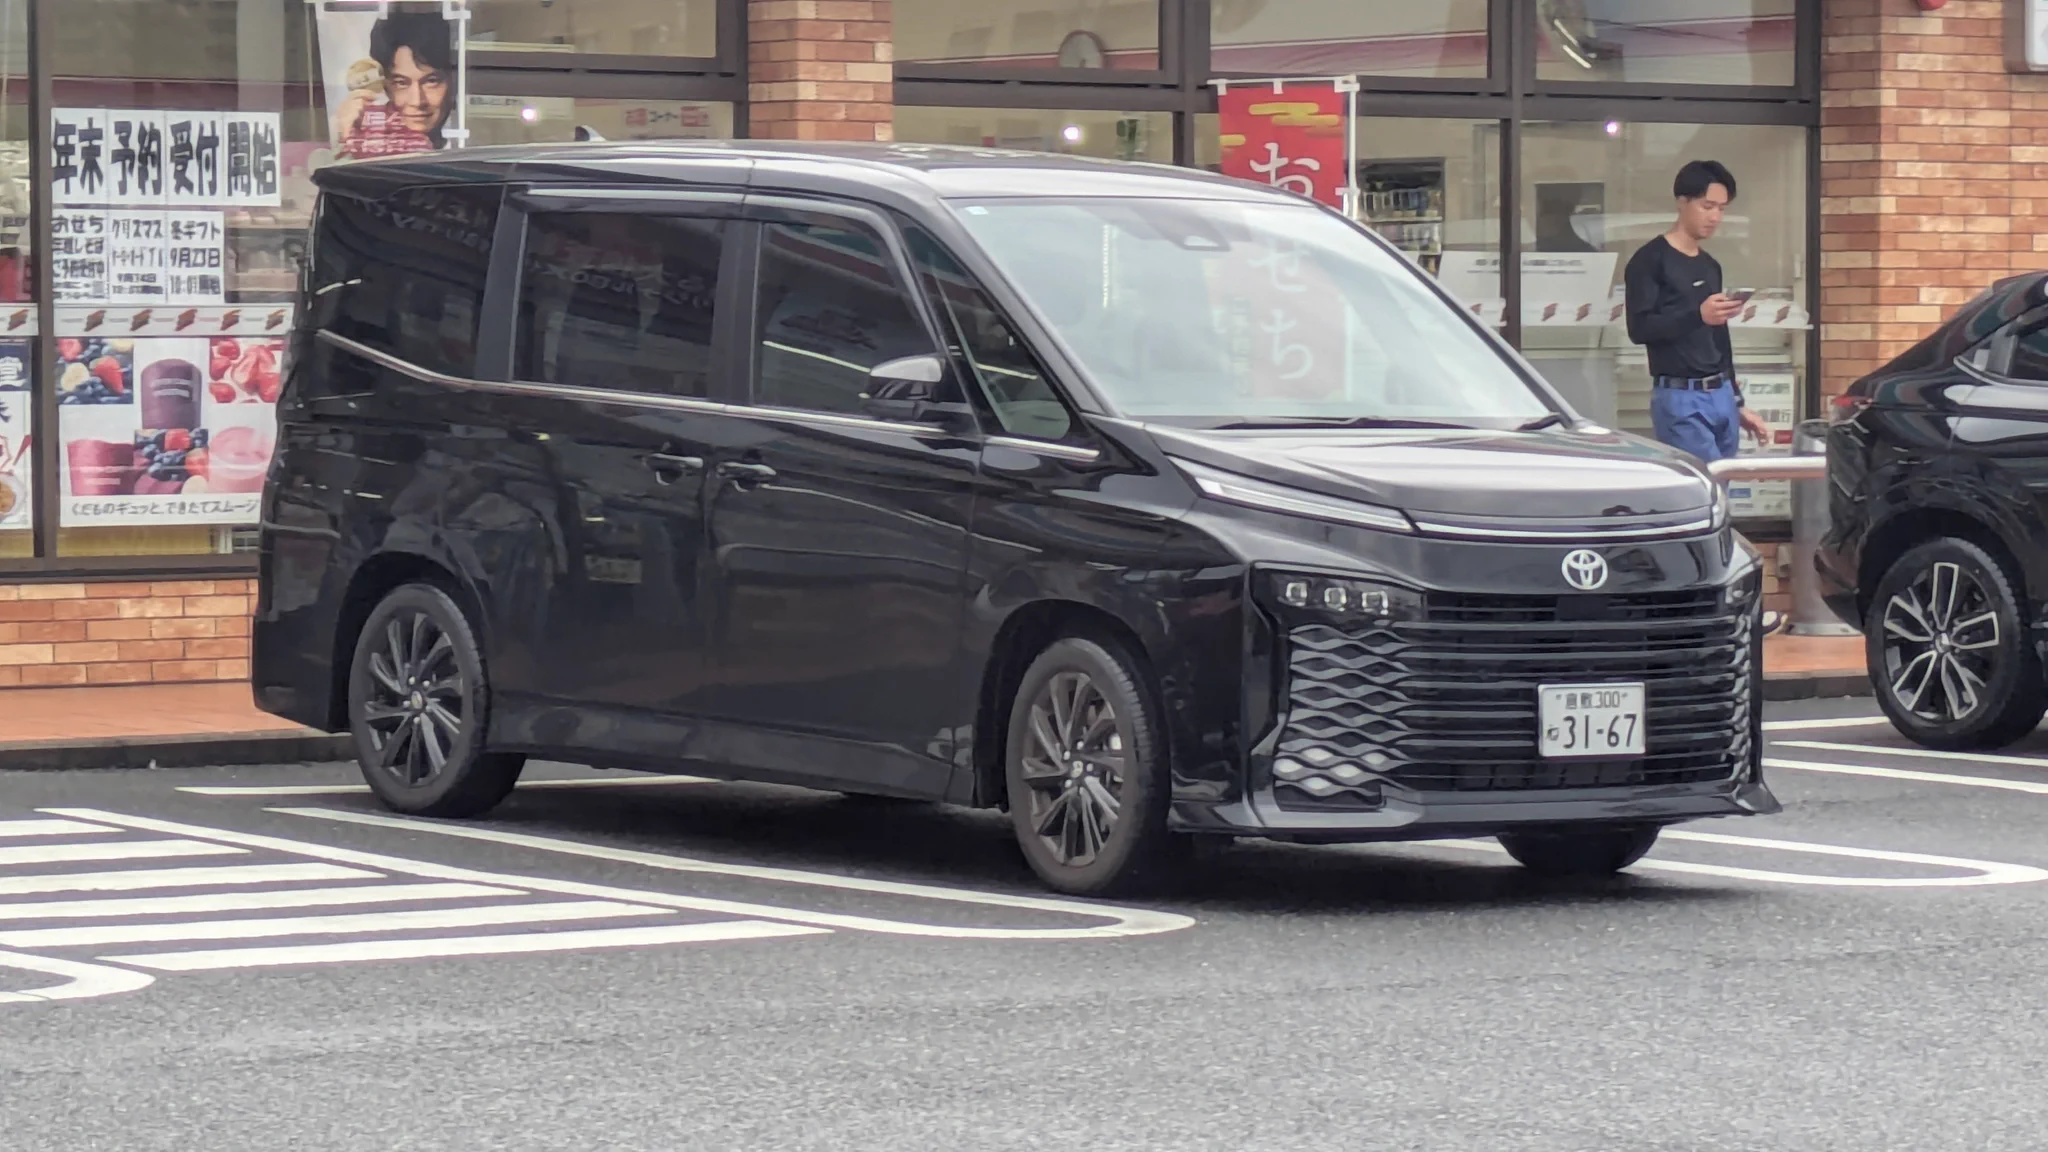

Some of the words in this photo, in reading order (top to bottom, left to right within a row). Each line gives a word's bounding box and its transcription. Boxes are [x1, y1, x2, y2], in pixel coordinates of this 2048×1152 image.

[52, 117, 277, 197] 年末予約受付開始
[51, 214, 105, 235] おせち
[111, 218, 163, 240] クリスマス
[170, 220, 221, 241] 冬ギフト
[170, 247, 221, 269] 9月23日
[1594, 691, 1620, 709] 300
[1562, 713, 1637, 749] 31-67
